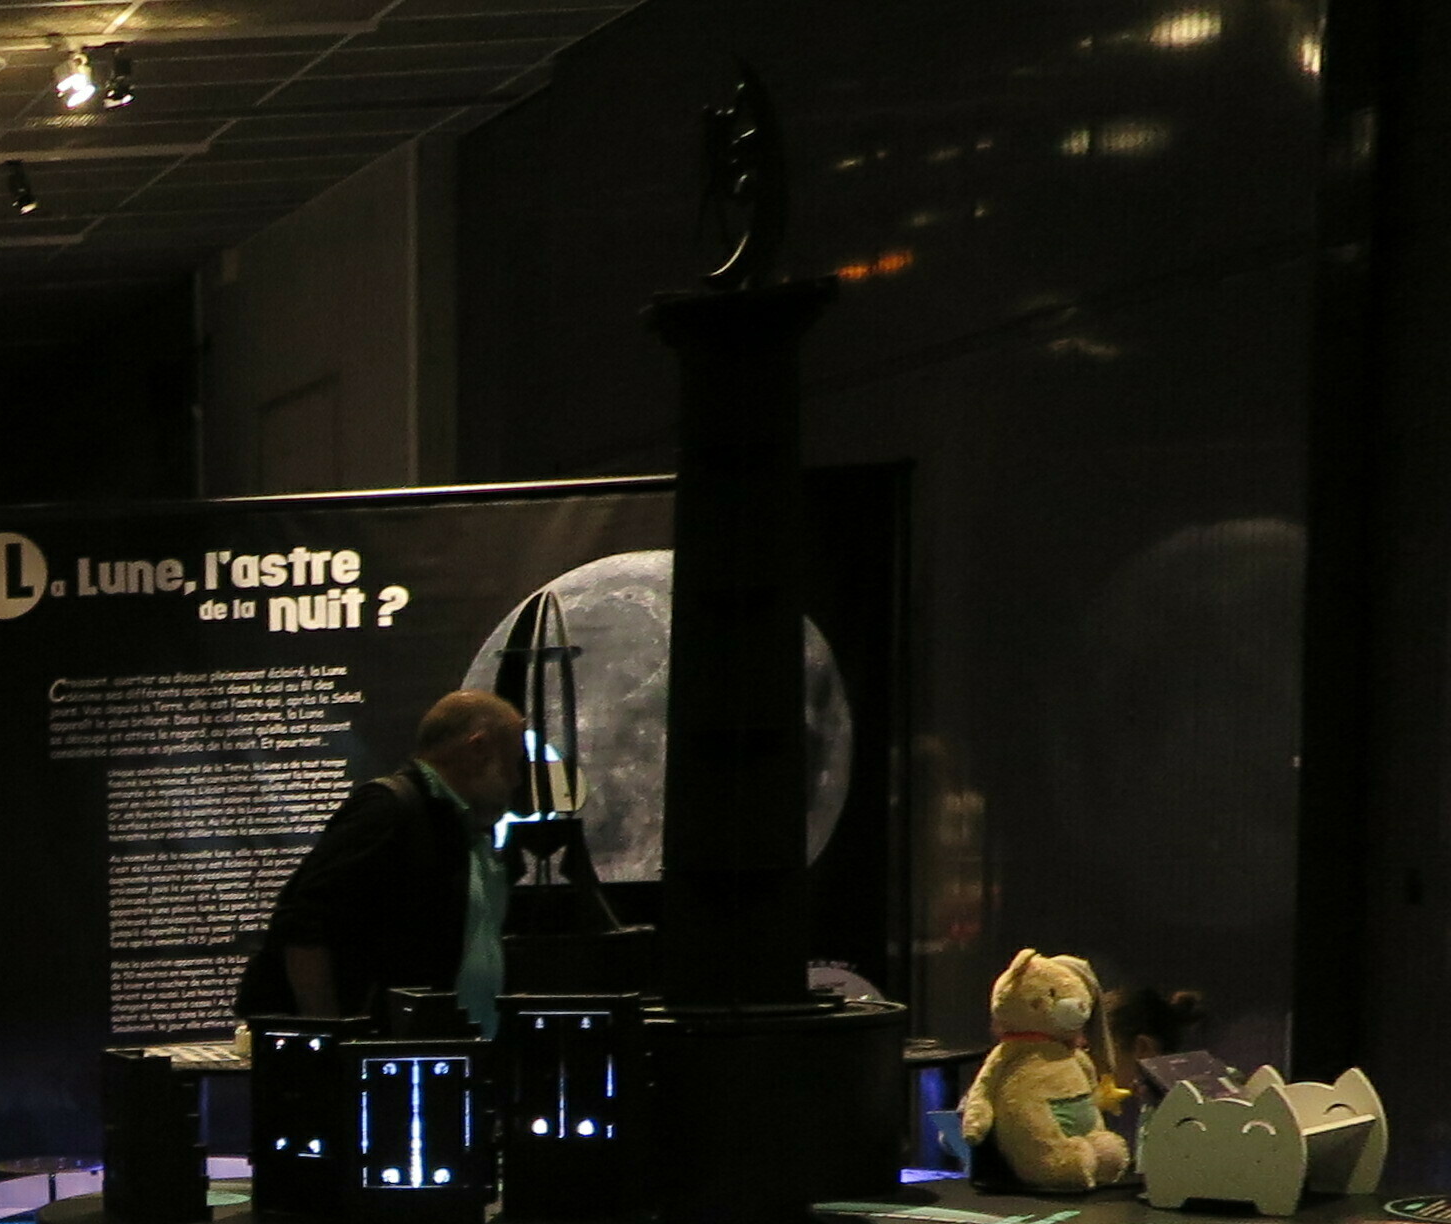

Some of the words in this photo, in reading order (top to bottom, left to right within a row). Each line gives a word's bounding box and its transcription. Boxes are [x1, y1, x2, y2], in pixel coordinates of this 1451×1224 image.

[78, 557, 197, 597] Lune,
[205, 546, 361, 590] l'astre
[199, 600, 227, 622] de
[233, 598, 255, 620] la
[269, 589, 366, 633] nuit
[377, 585, 410, 627] ?
